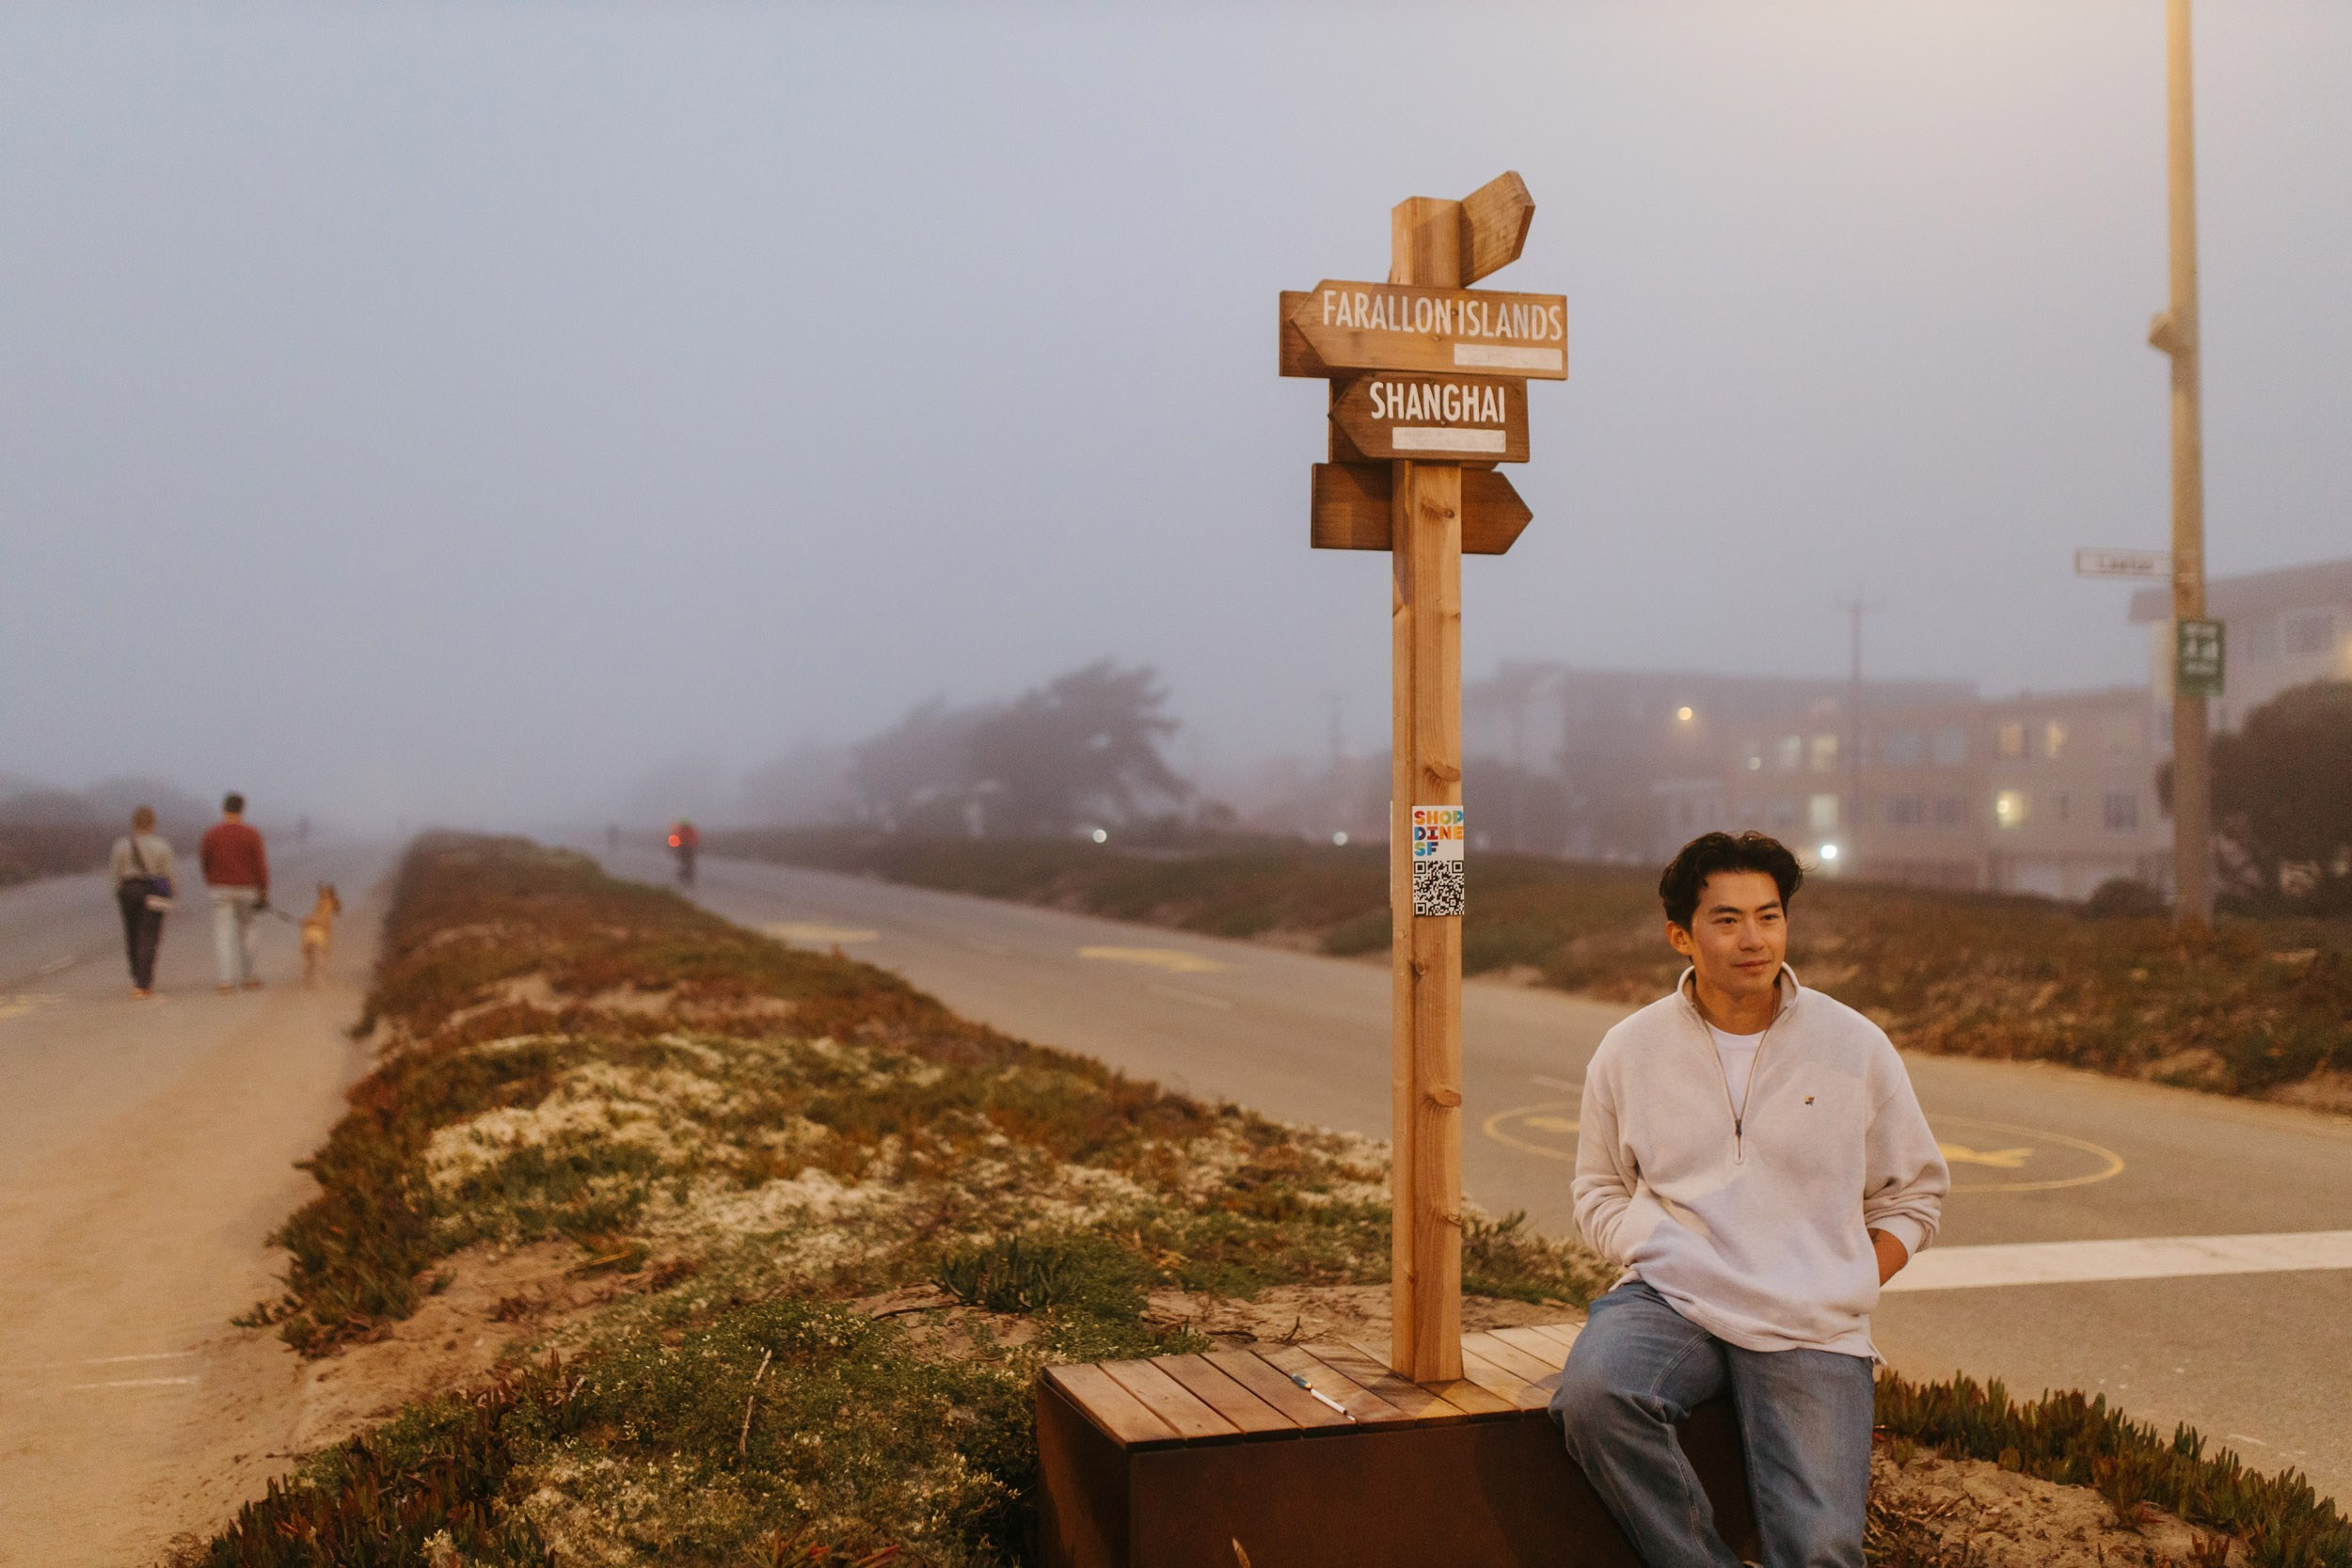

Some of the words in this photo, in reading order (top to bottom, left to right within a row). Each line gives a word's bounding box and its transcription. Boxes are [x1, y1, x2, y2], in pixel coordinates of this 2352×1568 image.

[1323, 290, 1452, 335] FARALLON
[1458, 300, 1563, 341] ISLANDS
[1370, 381, 1505, 422] SHANGHAI
[1414, 811, 1463, 825] SHOP
[1414, 826, 1463, 841] DINE
[1414, 842, 1438, 856] SF
